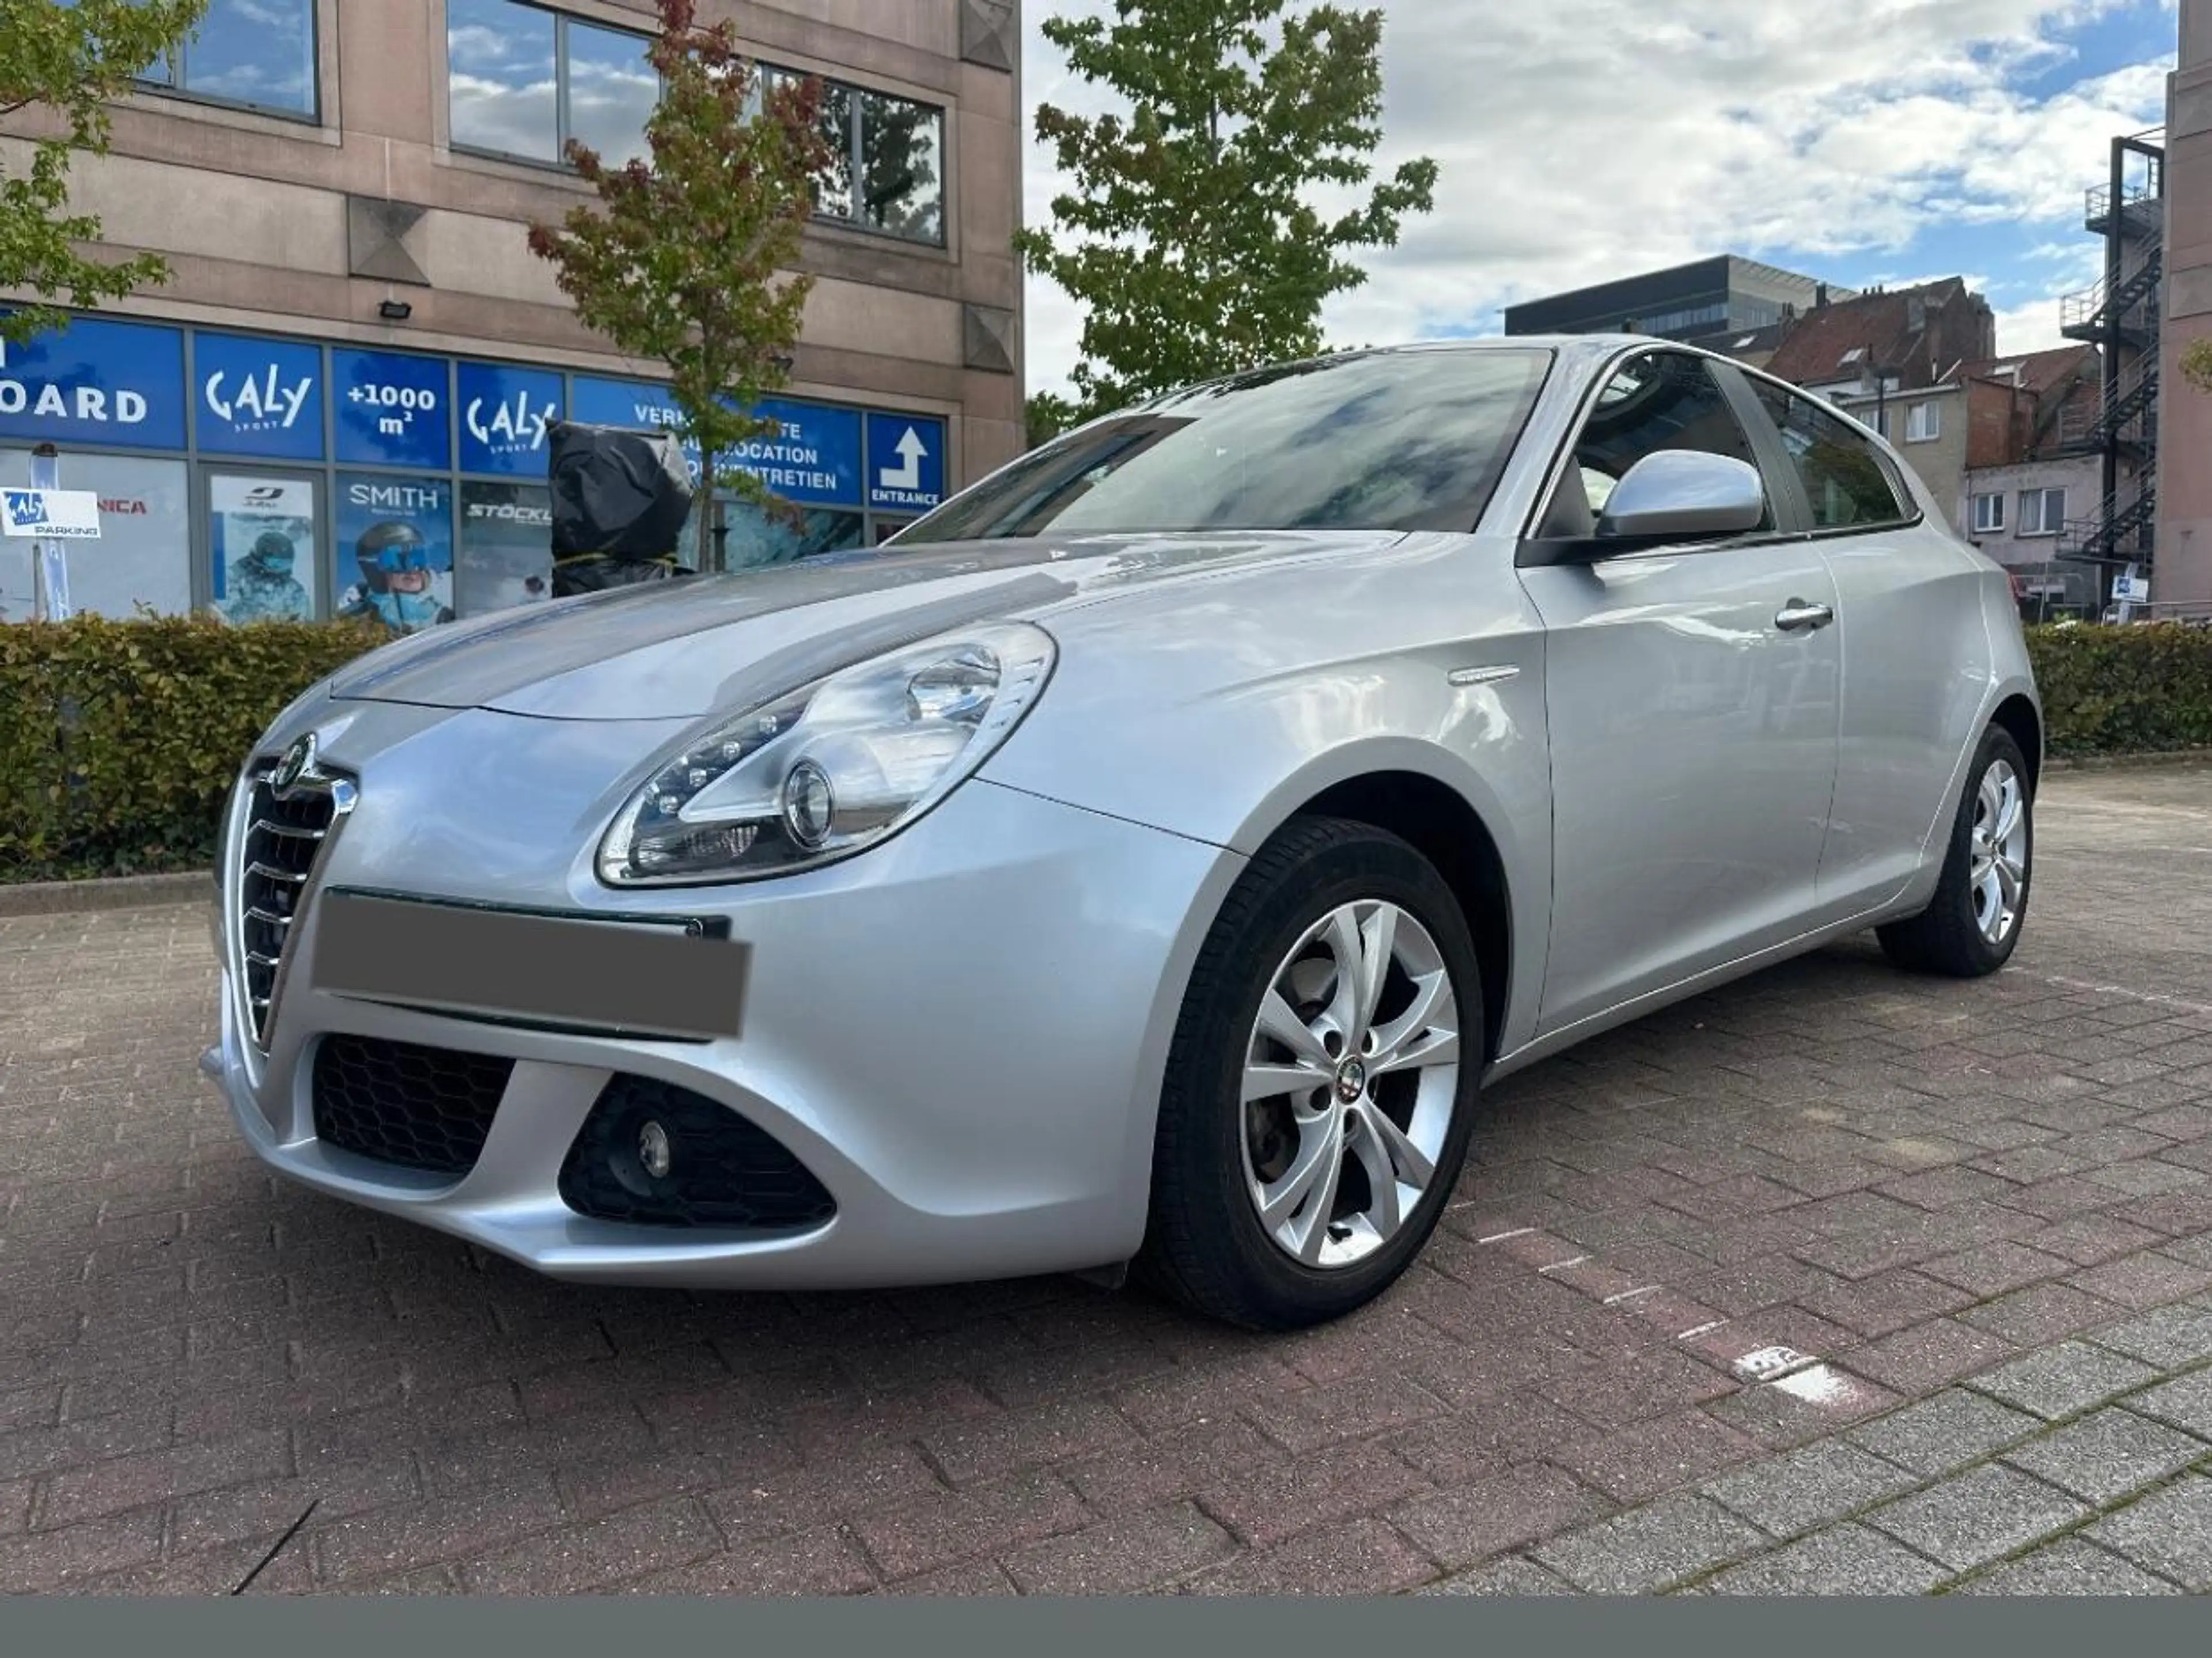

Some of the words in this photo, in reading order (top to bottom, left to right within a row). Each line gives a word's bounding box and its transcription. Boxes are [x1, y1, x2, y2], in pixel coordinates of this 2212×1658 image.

[347, 384, 436, 411] +1000
[350, 484, 438, 510] SMITH
[872, 488, 940, 504] ENTRANCE
[97, 499, 147, 514] NICA
[466, 502, 552, 521] STÖCKL
[35, 526, 98, 535] PARKING
